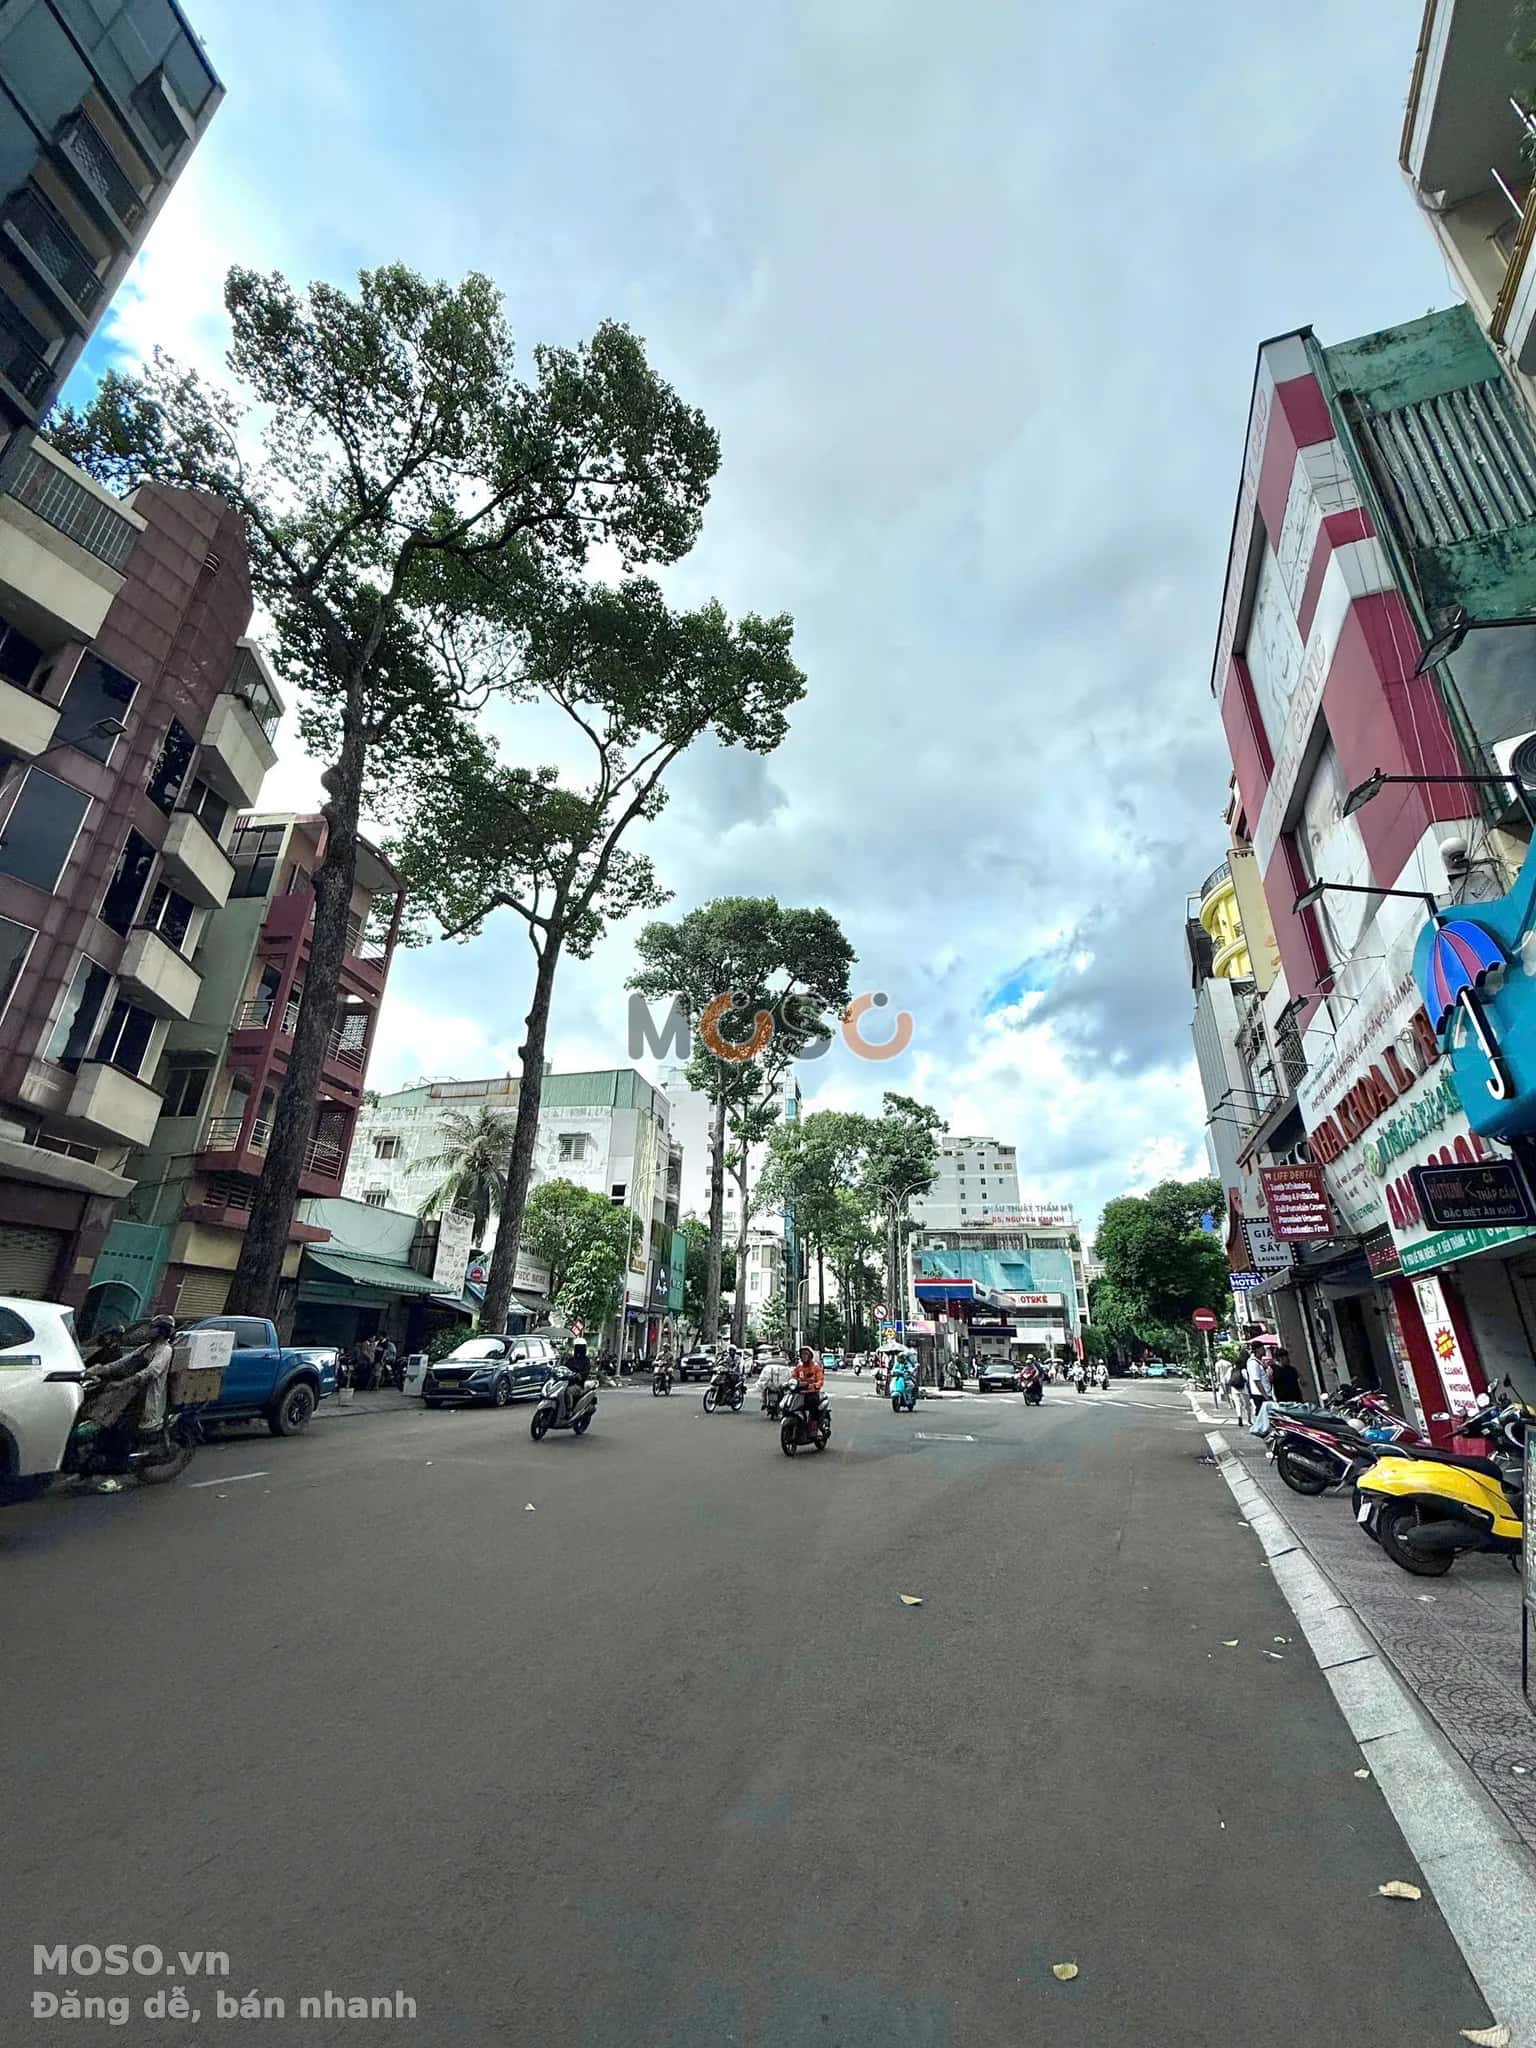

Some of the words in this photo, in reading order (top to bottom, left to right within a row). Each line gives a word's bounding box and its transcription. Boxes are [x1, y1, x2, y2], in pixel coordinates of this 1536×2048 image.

[1333, 1063, 1399, 1144] KHOA
[1289, 1170, 1317, 1180] DENTAL
[1254, 1228, 1274, 1240] GIẶ
[1259, 1241, 1281, 1253] SẤY
[1230, 1278, 1260, 1286] HOTEL
